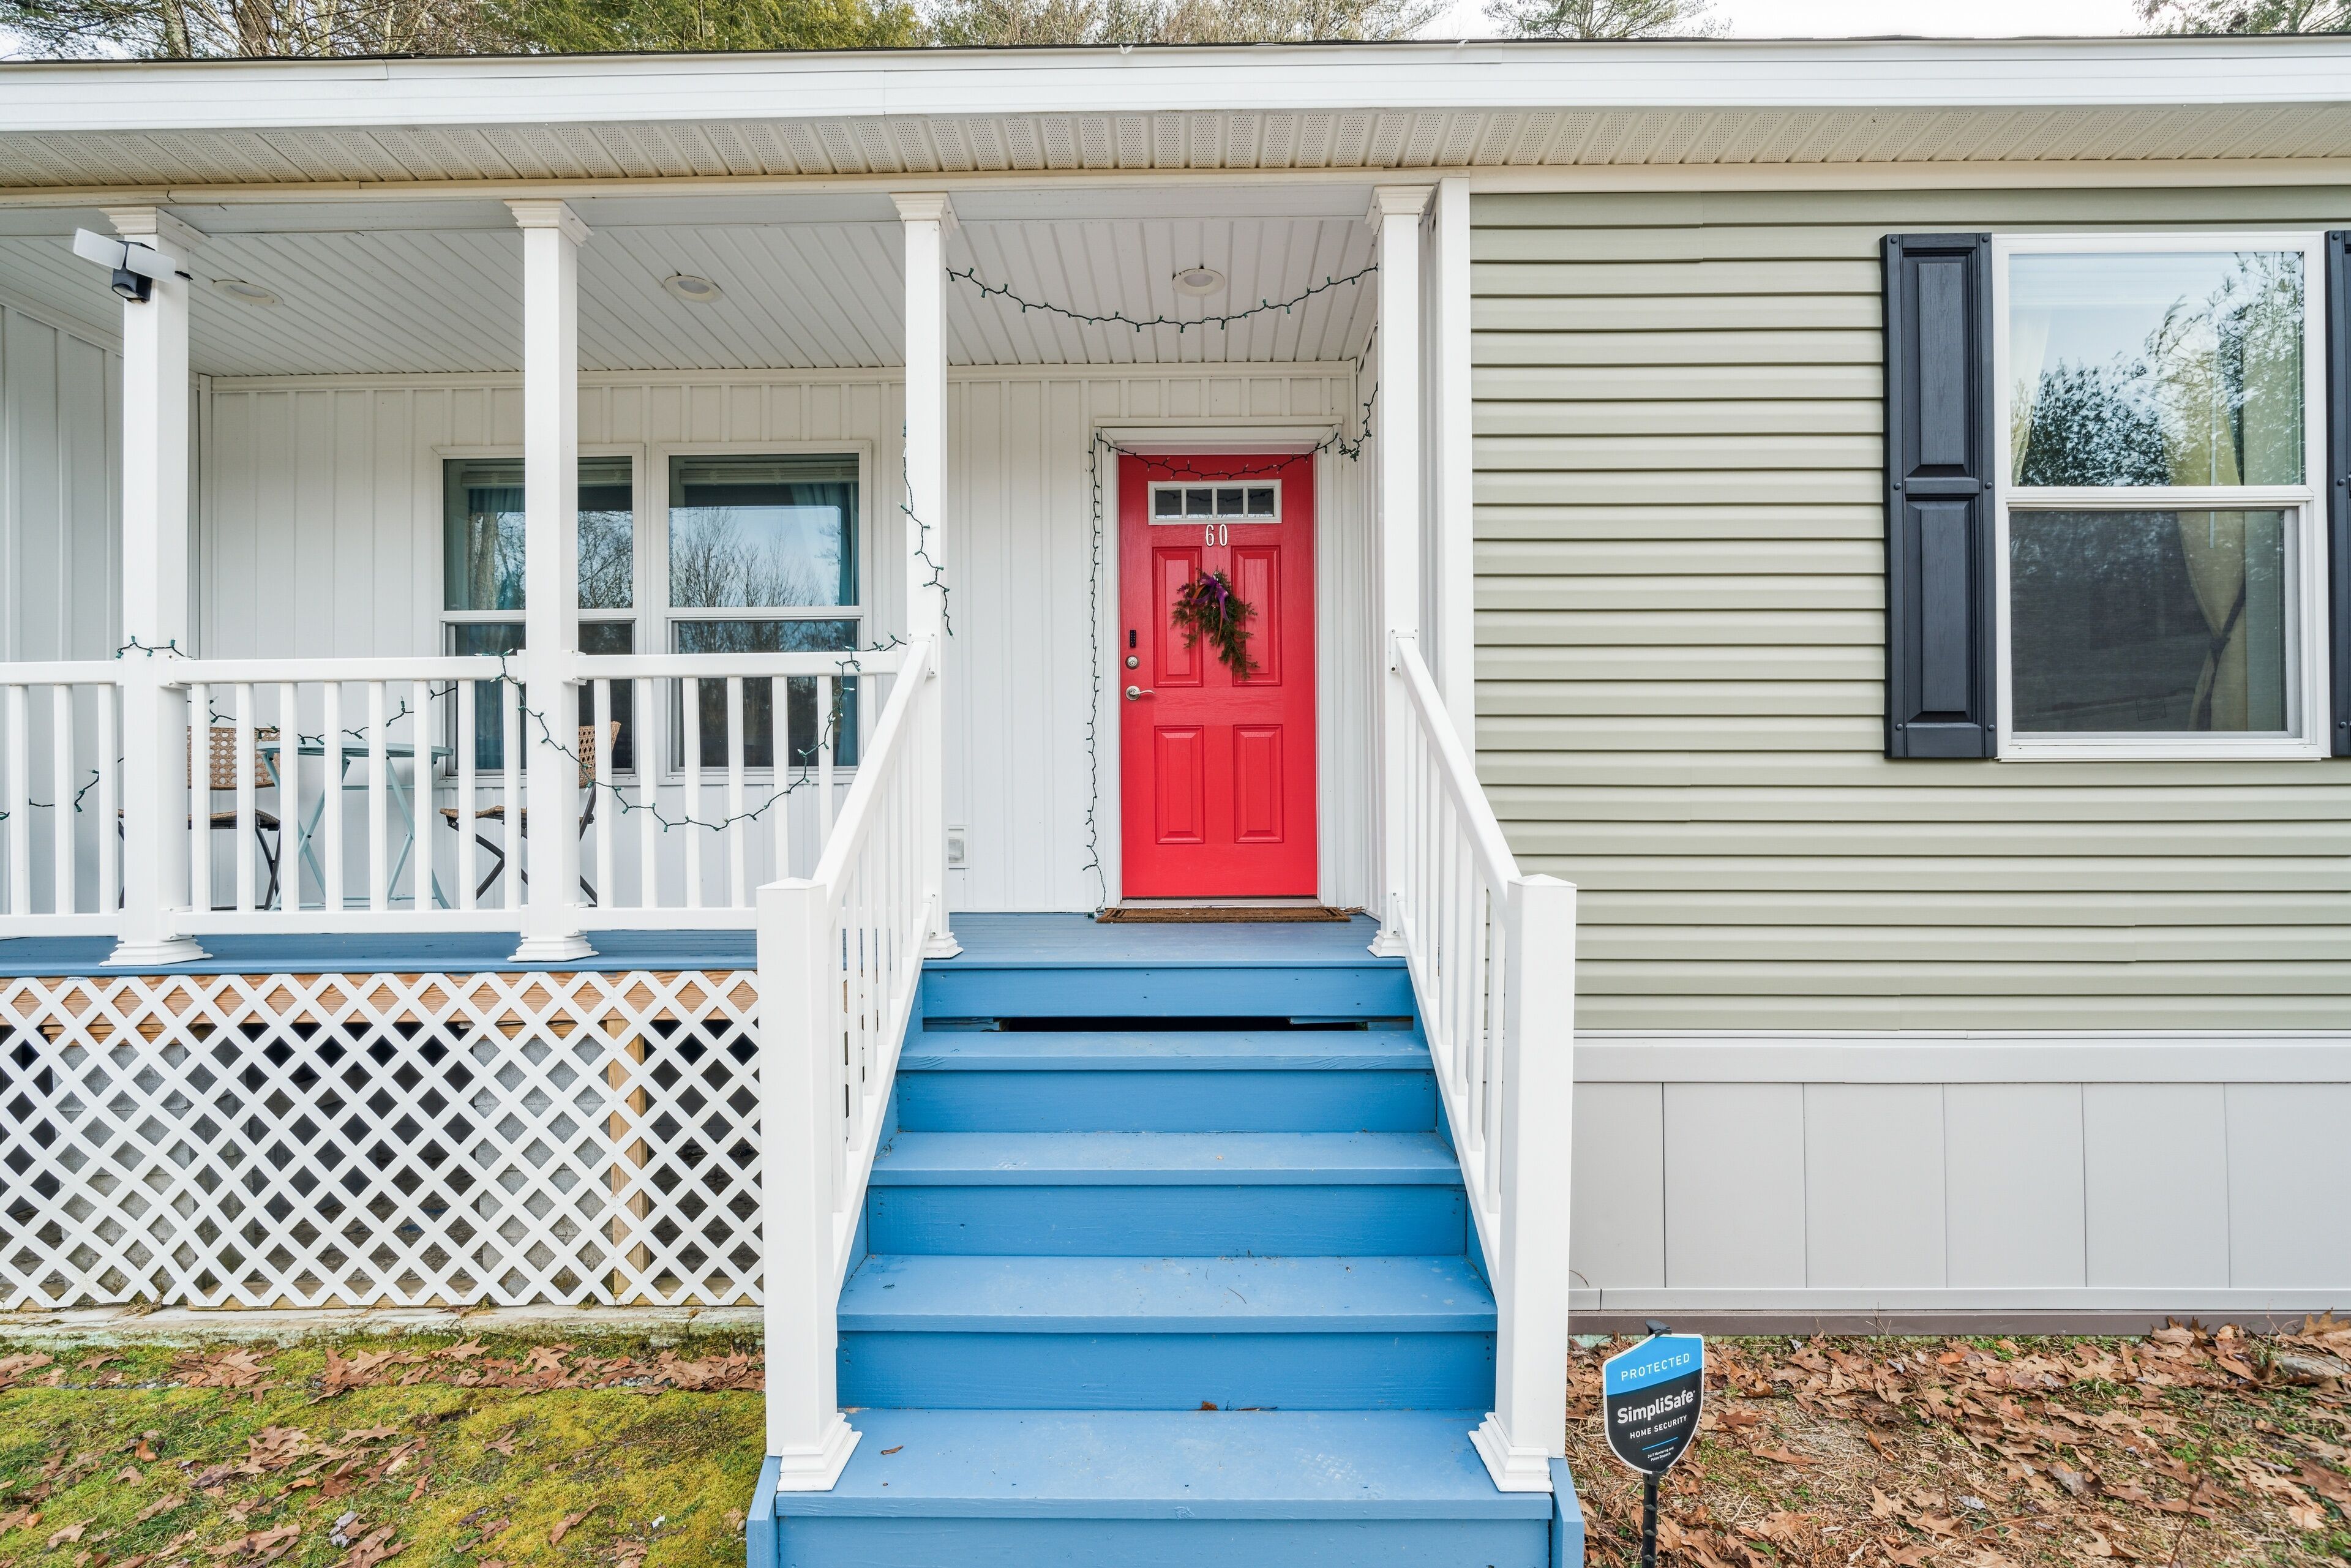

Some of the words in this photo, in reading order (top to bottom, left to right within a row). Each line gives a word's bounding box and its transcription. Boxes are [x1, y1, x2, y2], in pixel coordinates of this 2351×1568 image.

[1205, 523, 1228, 547] 60
[1621, 1353, 1690, 1381] PROTECTED
[1617, 1390, 1693, 1424] SimpliSafe
[1630, 1427, 1651, 1439] HOME
[1654, 1414, 1688, 1433] SECURITY
